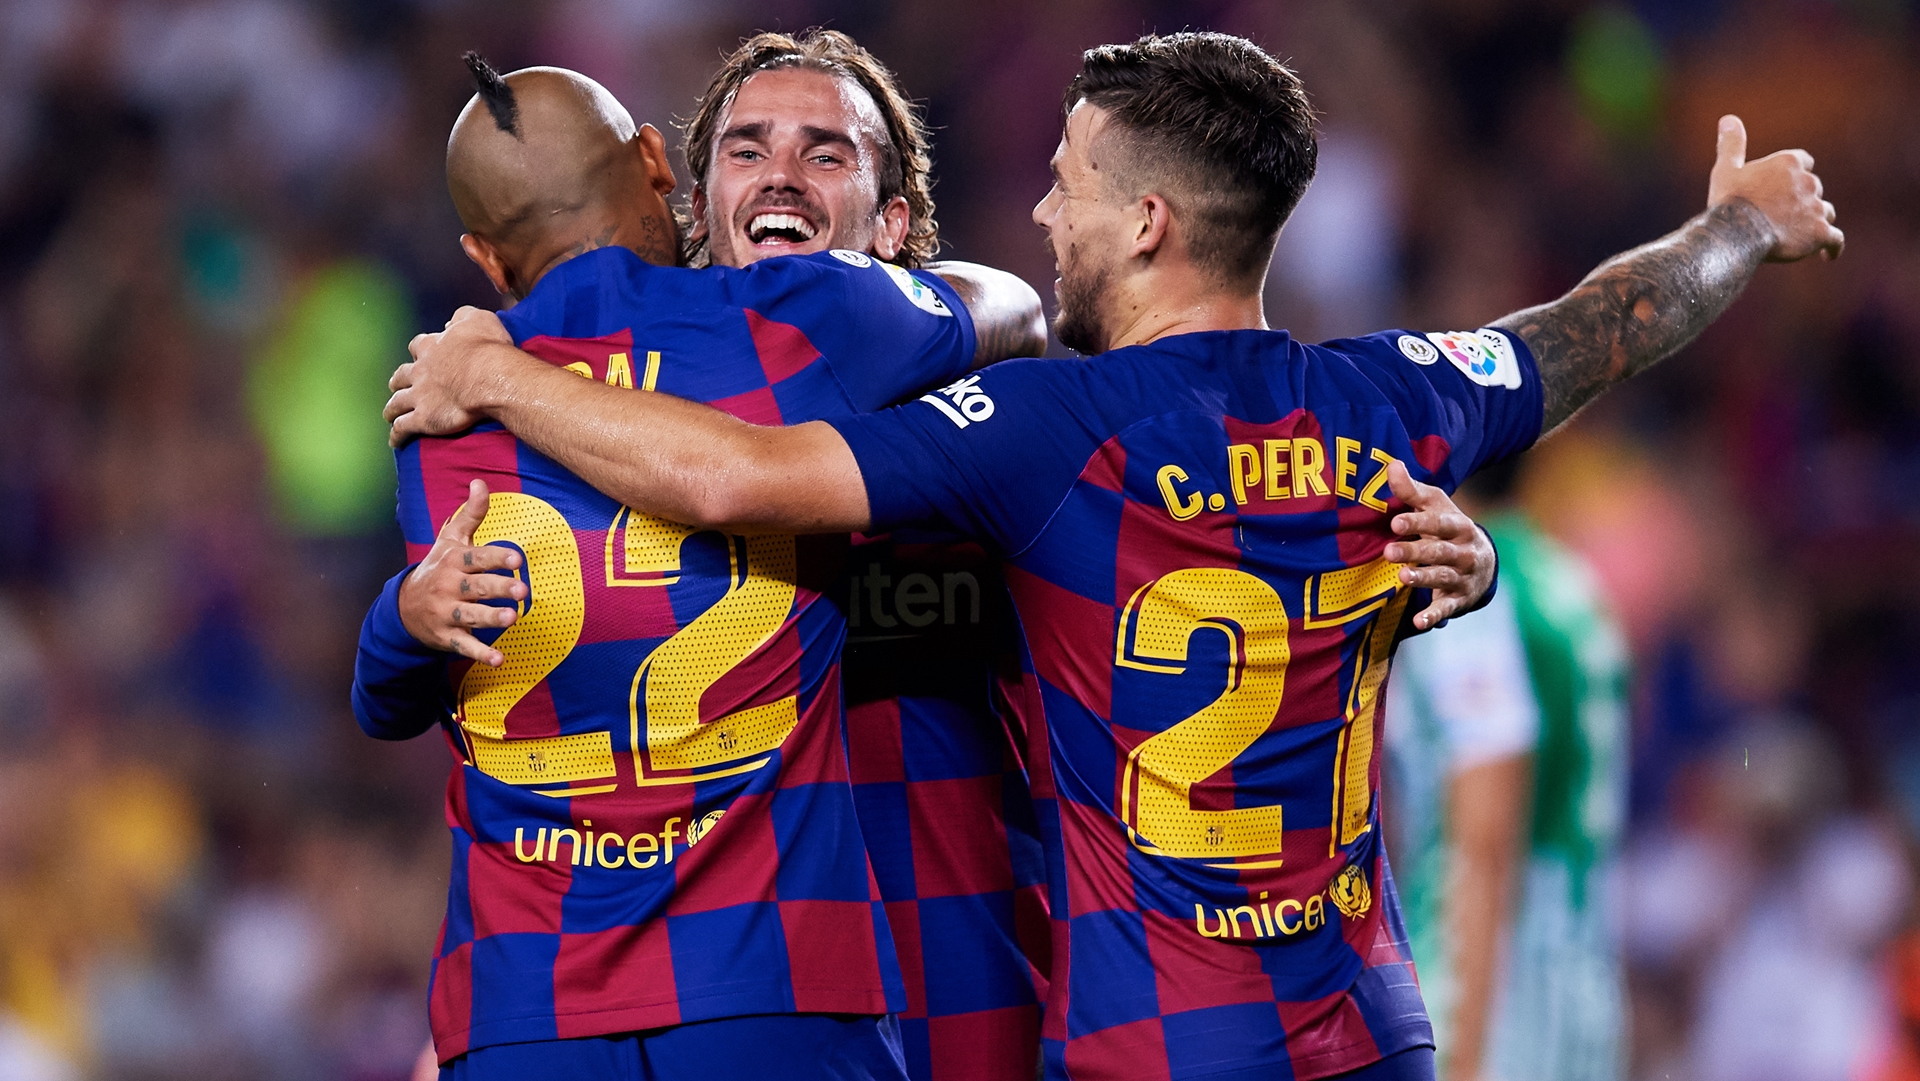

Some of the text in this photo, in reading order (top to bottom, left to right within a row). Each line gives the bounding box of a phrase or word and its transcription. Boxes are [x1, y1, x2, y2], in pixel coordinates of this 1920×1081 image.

[937, 375, 995, 422] ko
[1156, 436, 1400, 522] C. PEREZ
[441, 492, 798, 798] 22
[1115, 555, 1411, 869] 27
[514, 816, 682, 869] unicef
